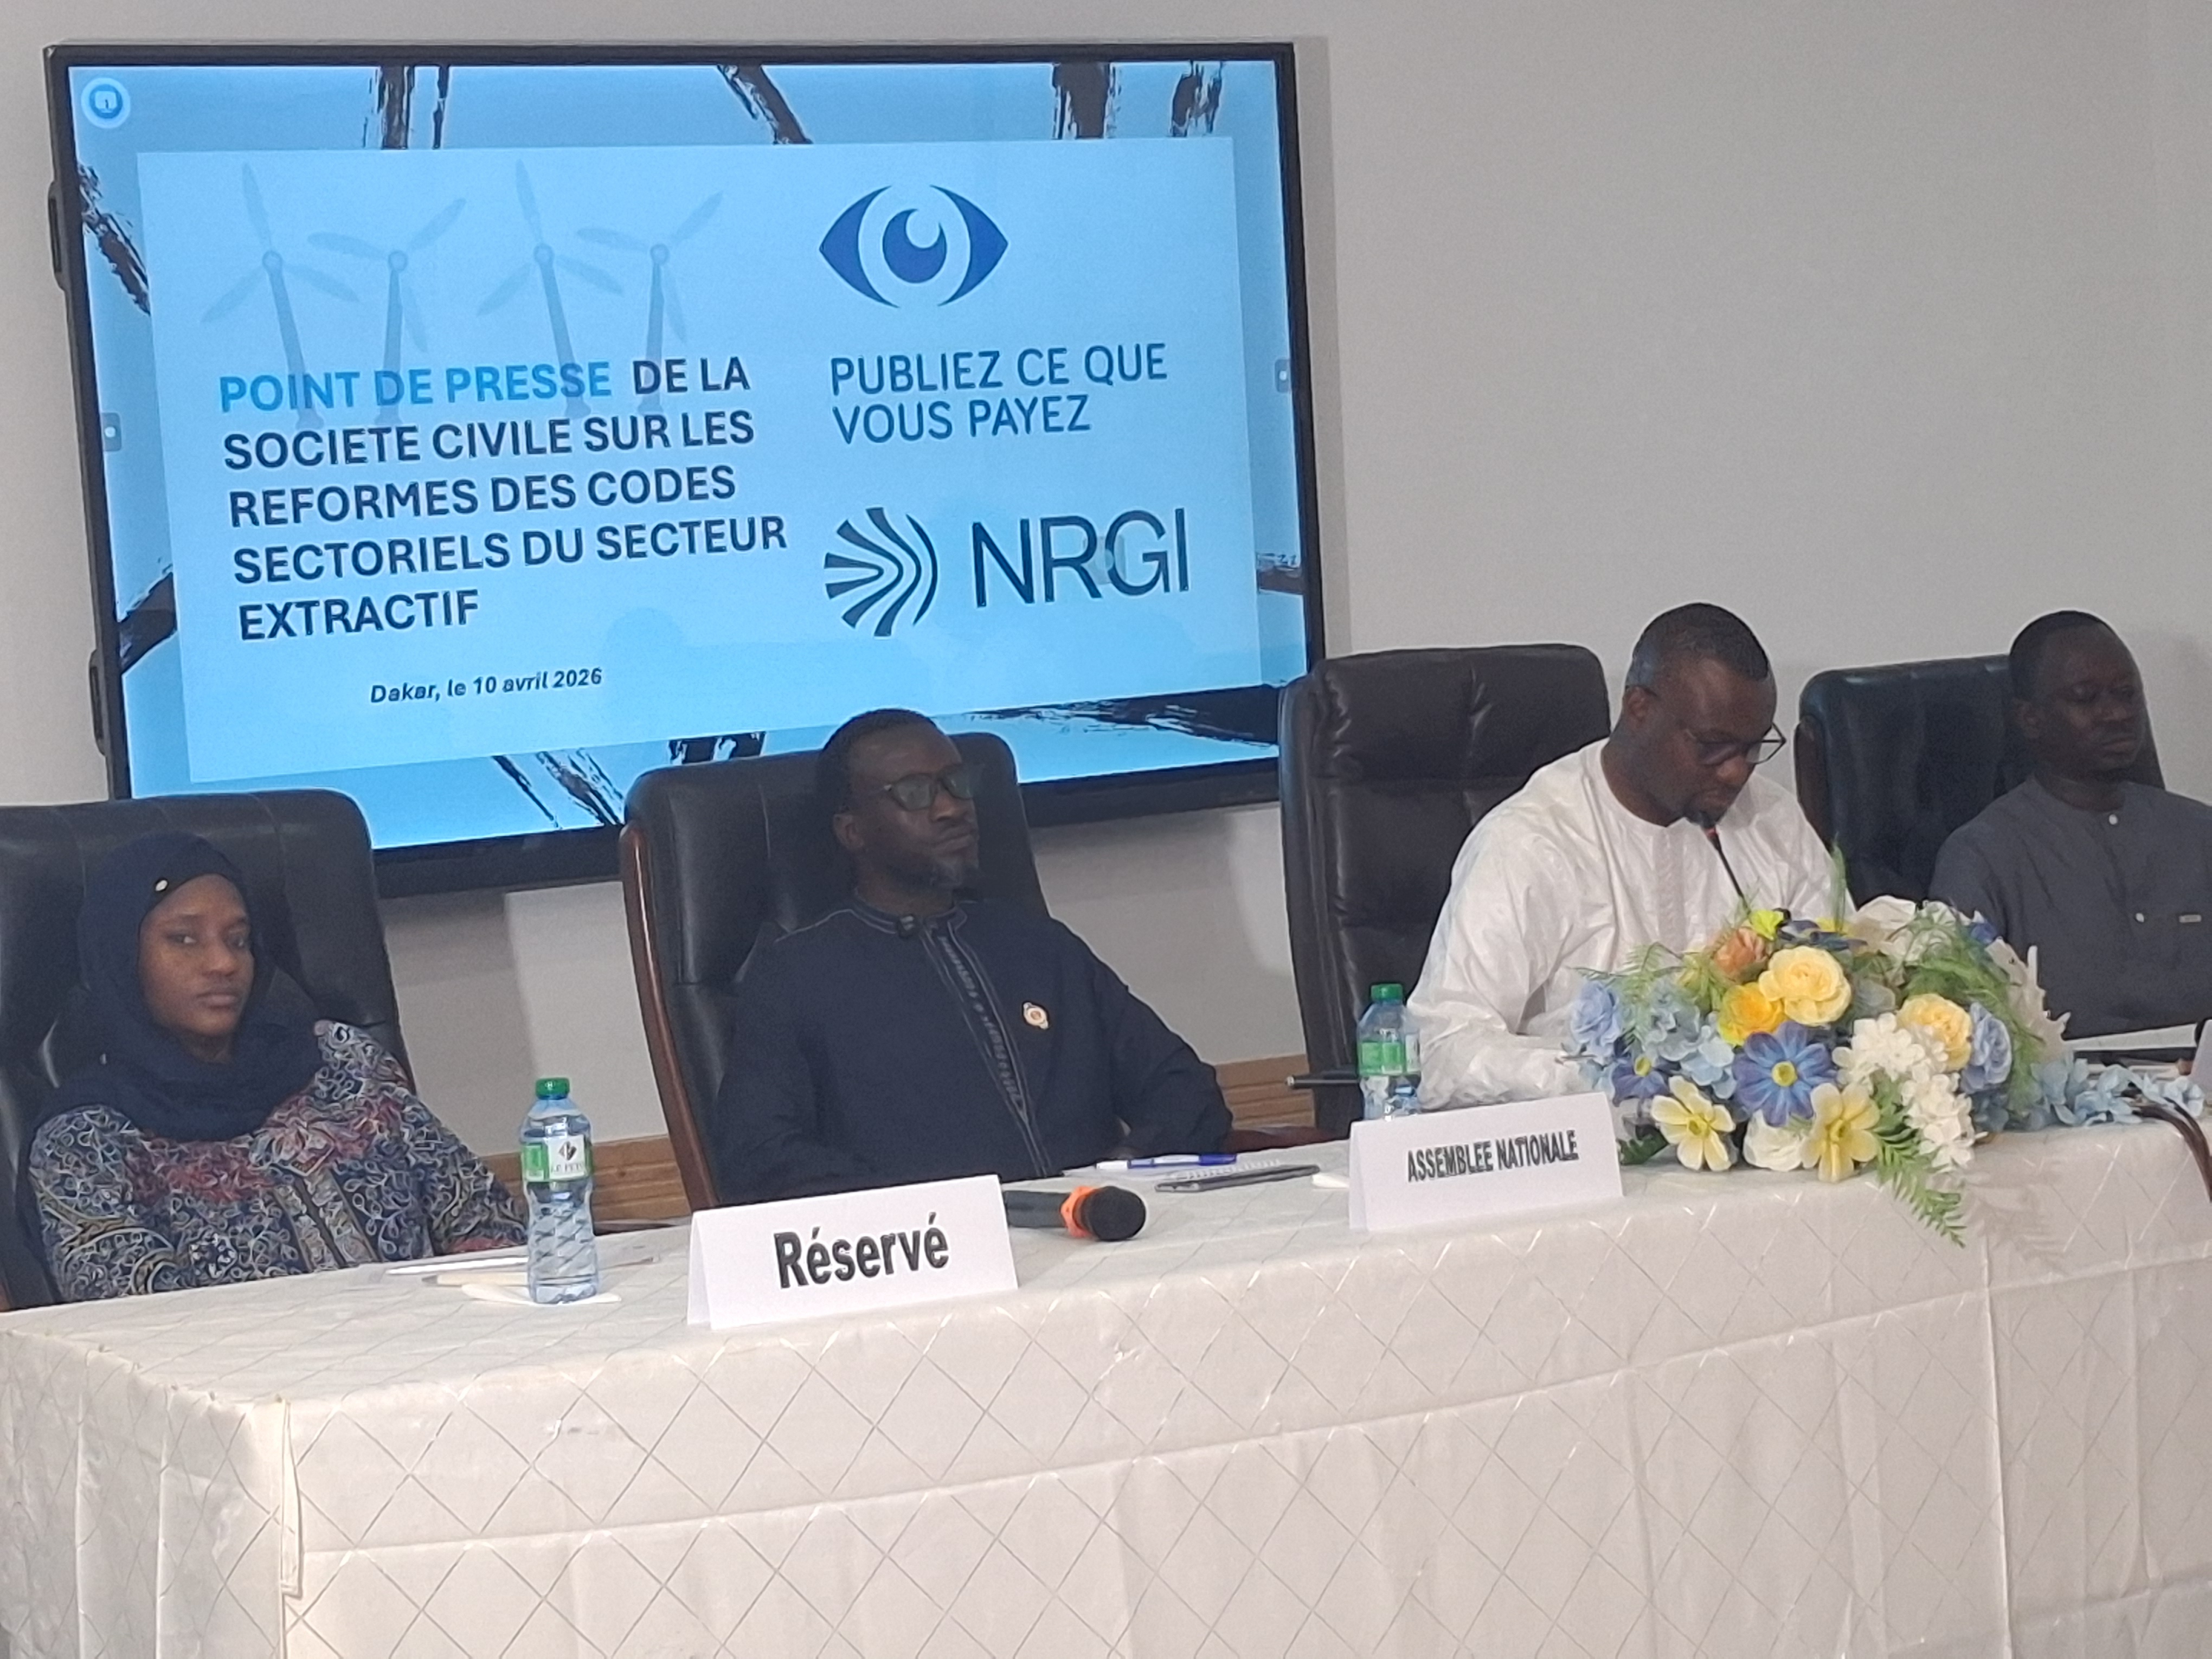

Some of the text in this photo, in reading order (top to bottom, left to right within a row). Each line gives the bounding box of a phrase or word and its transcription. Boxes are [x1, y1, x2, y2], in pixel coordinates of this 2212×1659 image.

[220, 357, 750, 413] POINT DE PRESSE DE LA
[831, 343, 1167, 396] PUBLIEZ CE QUE
[224, 410, 754, 470] SOCIETE CIVILE SUR LES
[832, 394, 1090, 444] VOUS PAYEZ
[230, 465, 735, 528] REFORMES DES CODES
[234, 516, 787, 583] SECTORIELS DU SECTEUR
[972, 509, 1188, 608] NRGI
[239, 589, 478, 640] EXTRACTIF
[371, 668, 602, 703] Dakar, le 10 avril 2026
[1409, 1130, 1579, 1182] ASSEMBLEE NATIONALE
[774, 1212, 948, 1288] Réservé
